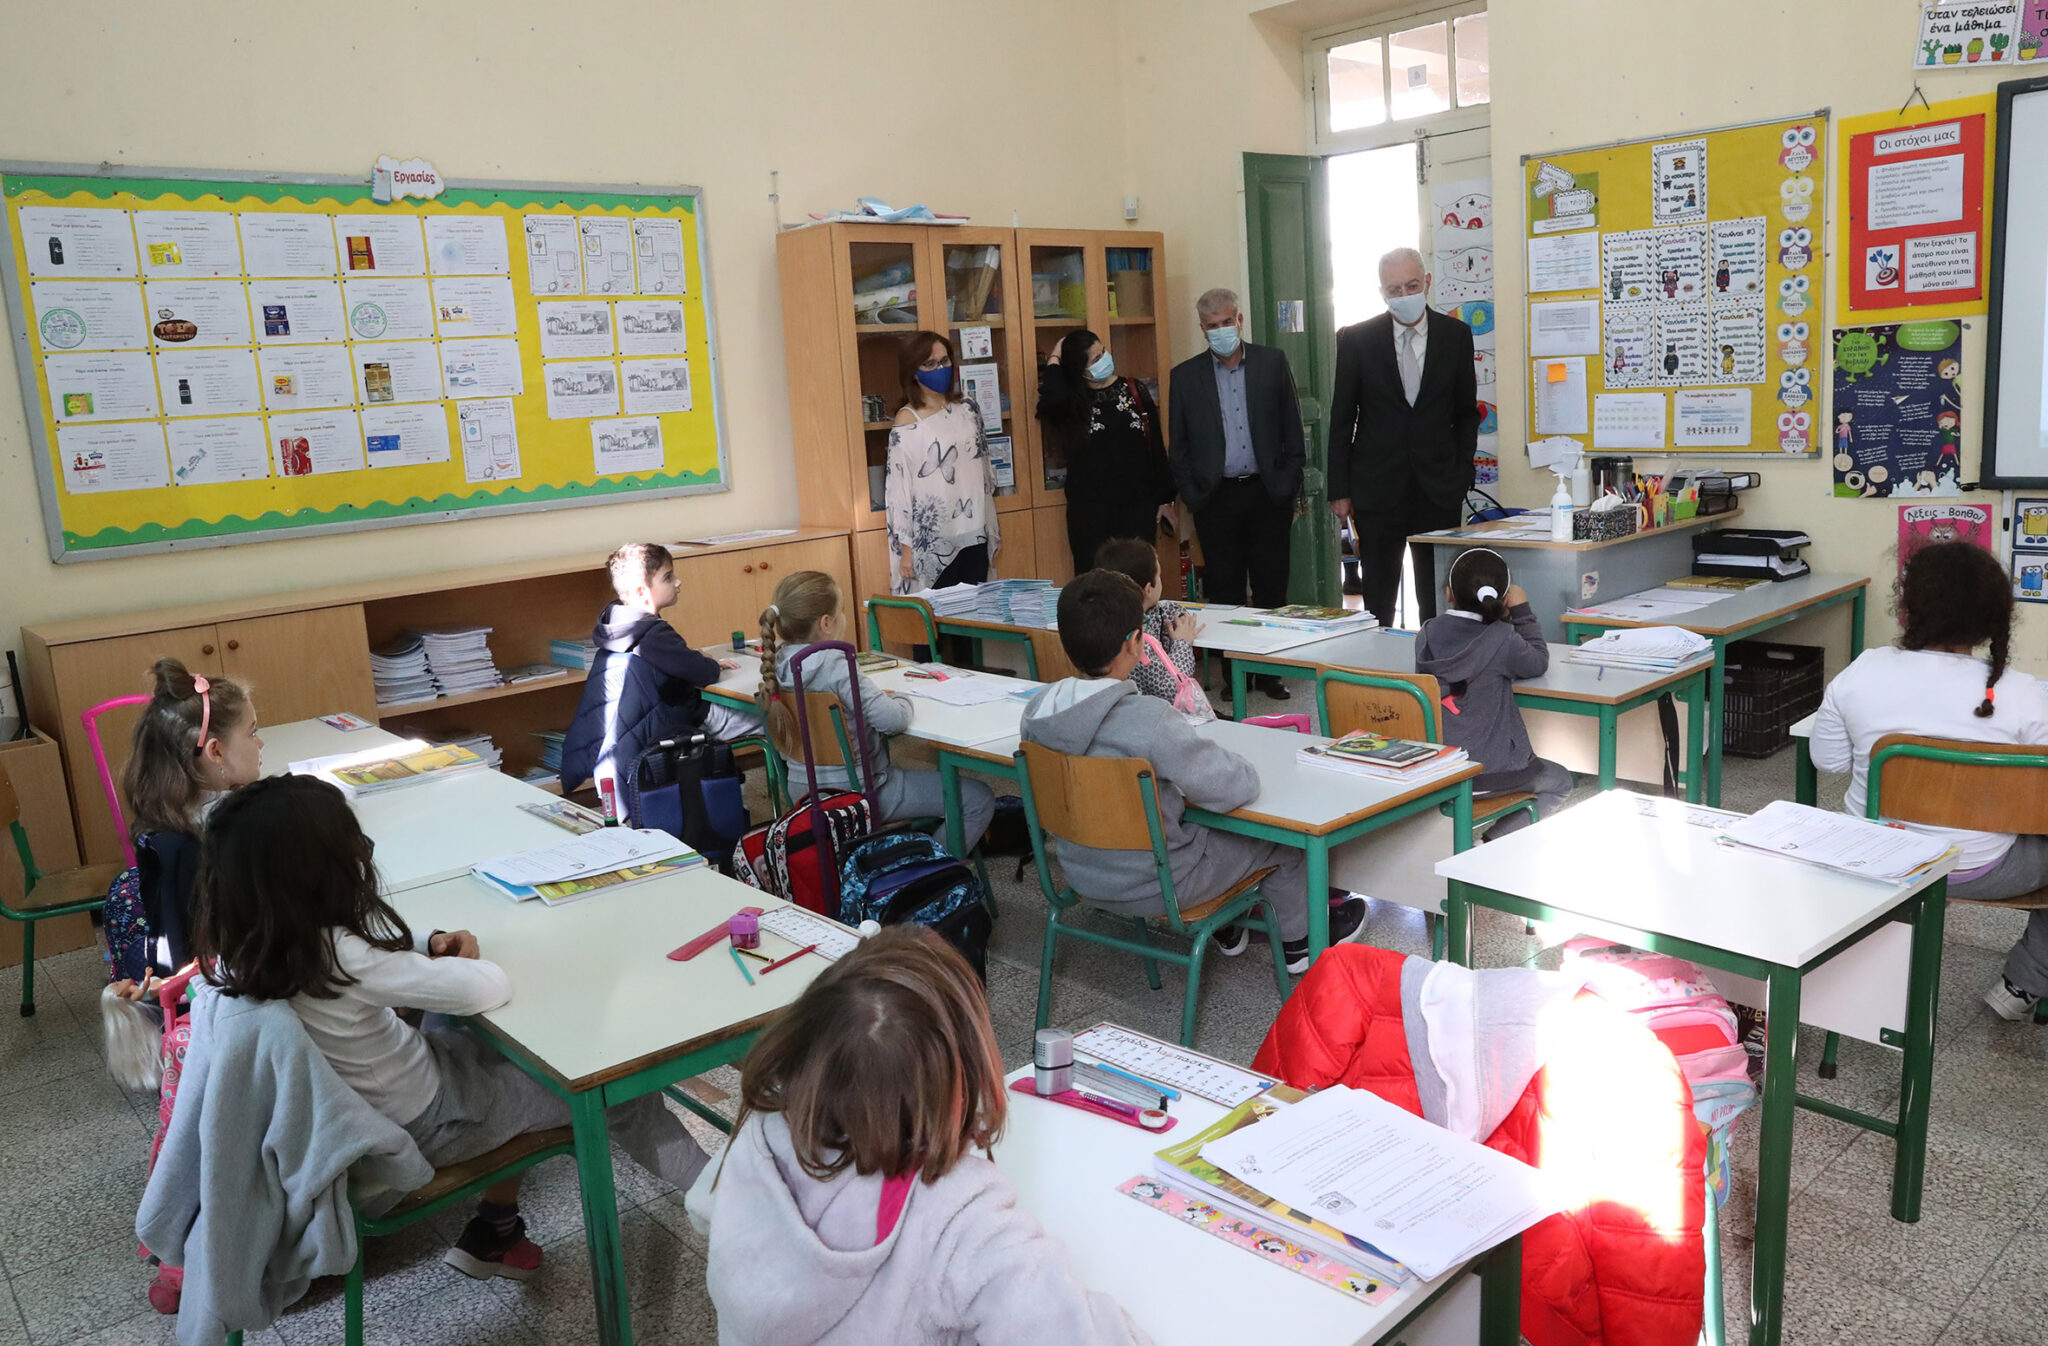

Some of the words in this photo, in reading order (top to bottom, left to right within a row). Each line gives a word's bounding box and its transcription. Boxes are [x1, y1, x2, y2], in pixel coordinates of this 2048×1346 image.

[1961, 4, 2016, 19] τελειώσει
[1929, 23, 1951, 33] ένα
[1954, 19, 2001, 34] μάθημα
[1879, 140, 1892, 149] Οι
[1894, 135, 1931, 148] στόχοι
[1934, 130, 1955, 142] μας
[1787, 155, 1809, 163] ΔΕΥΤΕΡΑ
[394, 170, 435, 184] Εργασίες
[1913, 241, 1929, 249] Μην
[1931, 238, 1957, 248] ξεχνάς!
[1912, 250, 1934, 259] άτομο
[1911, 260, 1946, 269] υπεύθυνο
[1948, 258, 1959, 266] για
[1909, 270, 1936, 280] μάθησή
[1922, 280, 1940, 288] μόνο
[1941, 279, 1957, 287] εσύ!
[1907, 508, 1938, 521] Λέξεις
[1948, 507, 1985, 521] Βοηθοί
